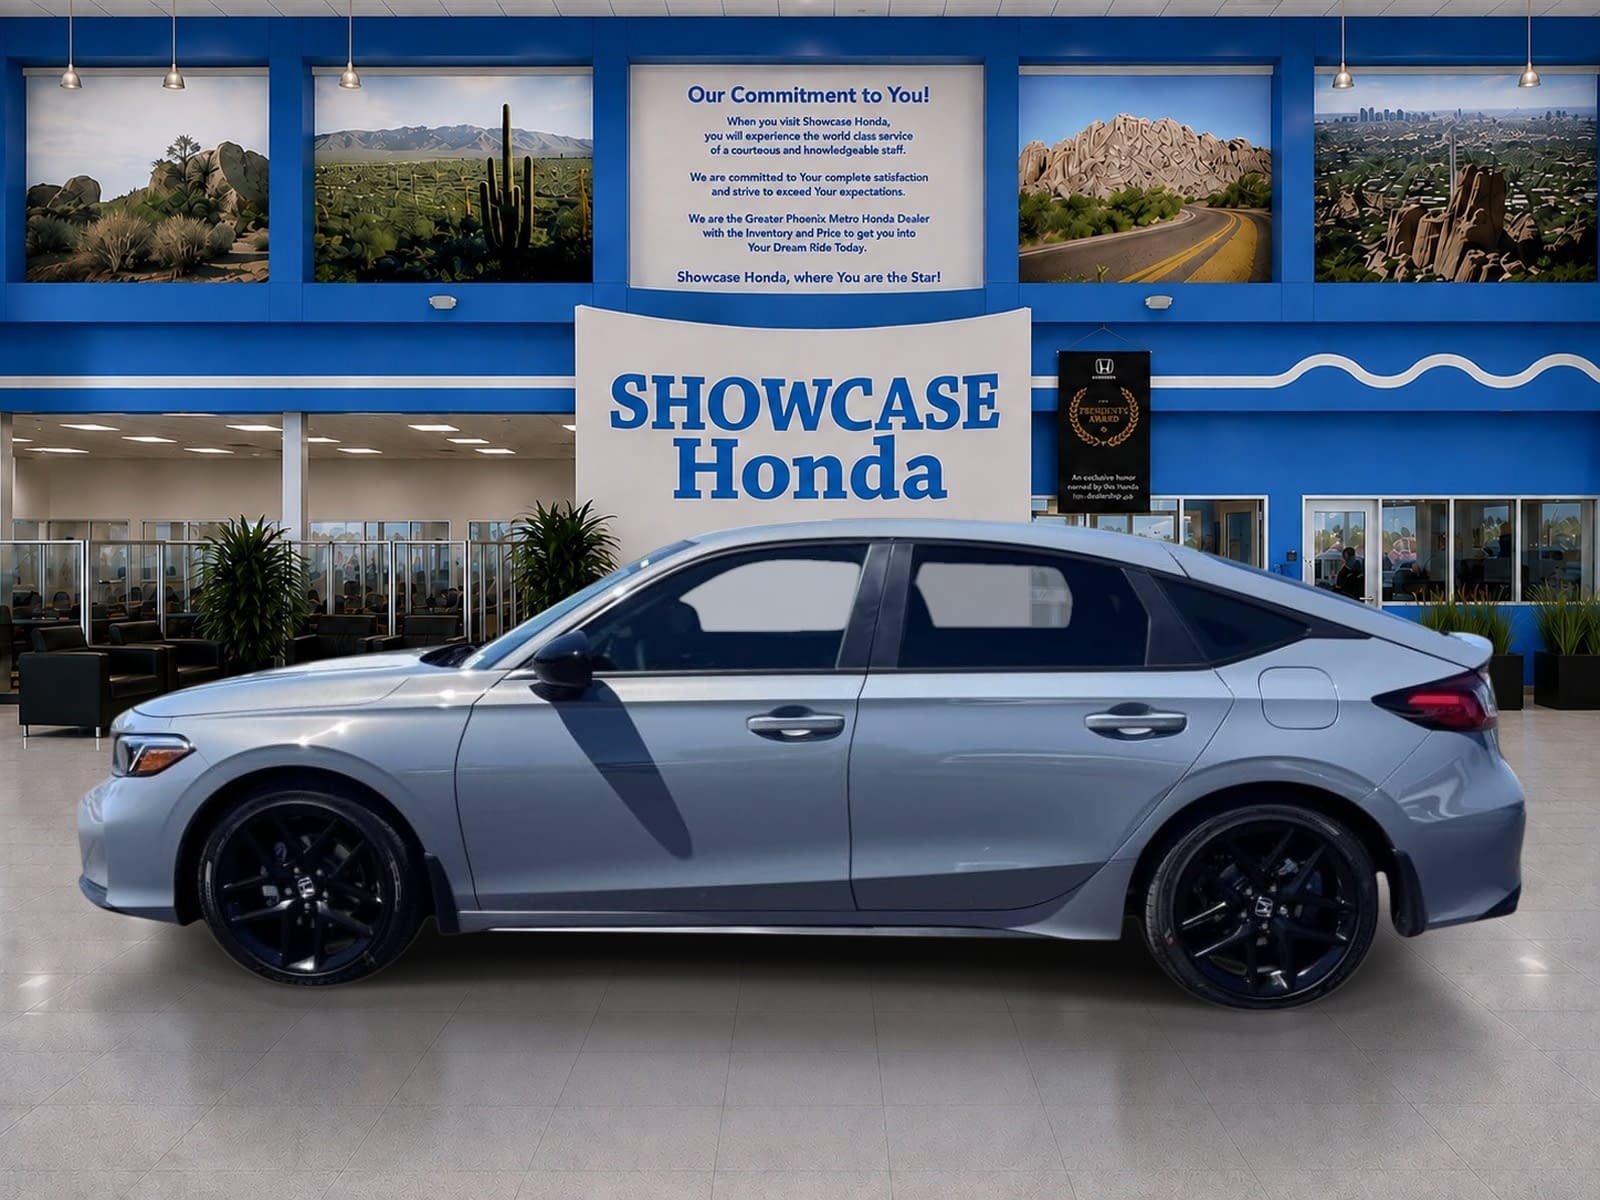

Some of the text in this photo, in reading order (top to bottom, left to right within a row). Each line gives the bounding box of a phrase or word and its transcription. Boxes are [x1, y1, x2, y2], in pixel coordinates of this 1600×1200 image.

[688, 85, 929, 103] Our Commitment to You!
[727, 116, 890, 129] When you visit Showcase Honda,
[704, 131, 913, 143] you will experience the world class service
[710, 144, 721, 155] of
[723, 147, 729, 155] a
[731, 146, 781, 155] courteous
[783, 145, 801, 155] and
[881, 144, 906, 155] staff.
[690, 172, 707, 182] We
[728, 172, 783, 182] committed
[786, 174, 797, 182] to
[799, 172, 822, 182] Your
[825, 172, 871, 185] complete
[873, 172, 929, 182] satisfaction
[711, 186, 905, 199] and strive to exceed Your expectations.
[688, 213, 930, 224] We are the Greater Phoenix Metro Honda Dealer
[702, 228, 916, 241] with the Inventory and Price to get you into
[748, 242, 867, 255] Your Dream Ride Today.
[677, 270, 941, 285] Showcase Honda, where You are the Star!
[610, 373, 1000, 431] SHOWCASE
[673, 434, 948, 501] Honda
